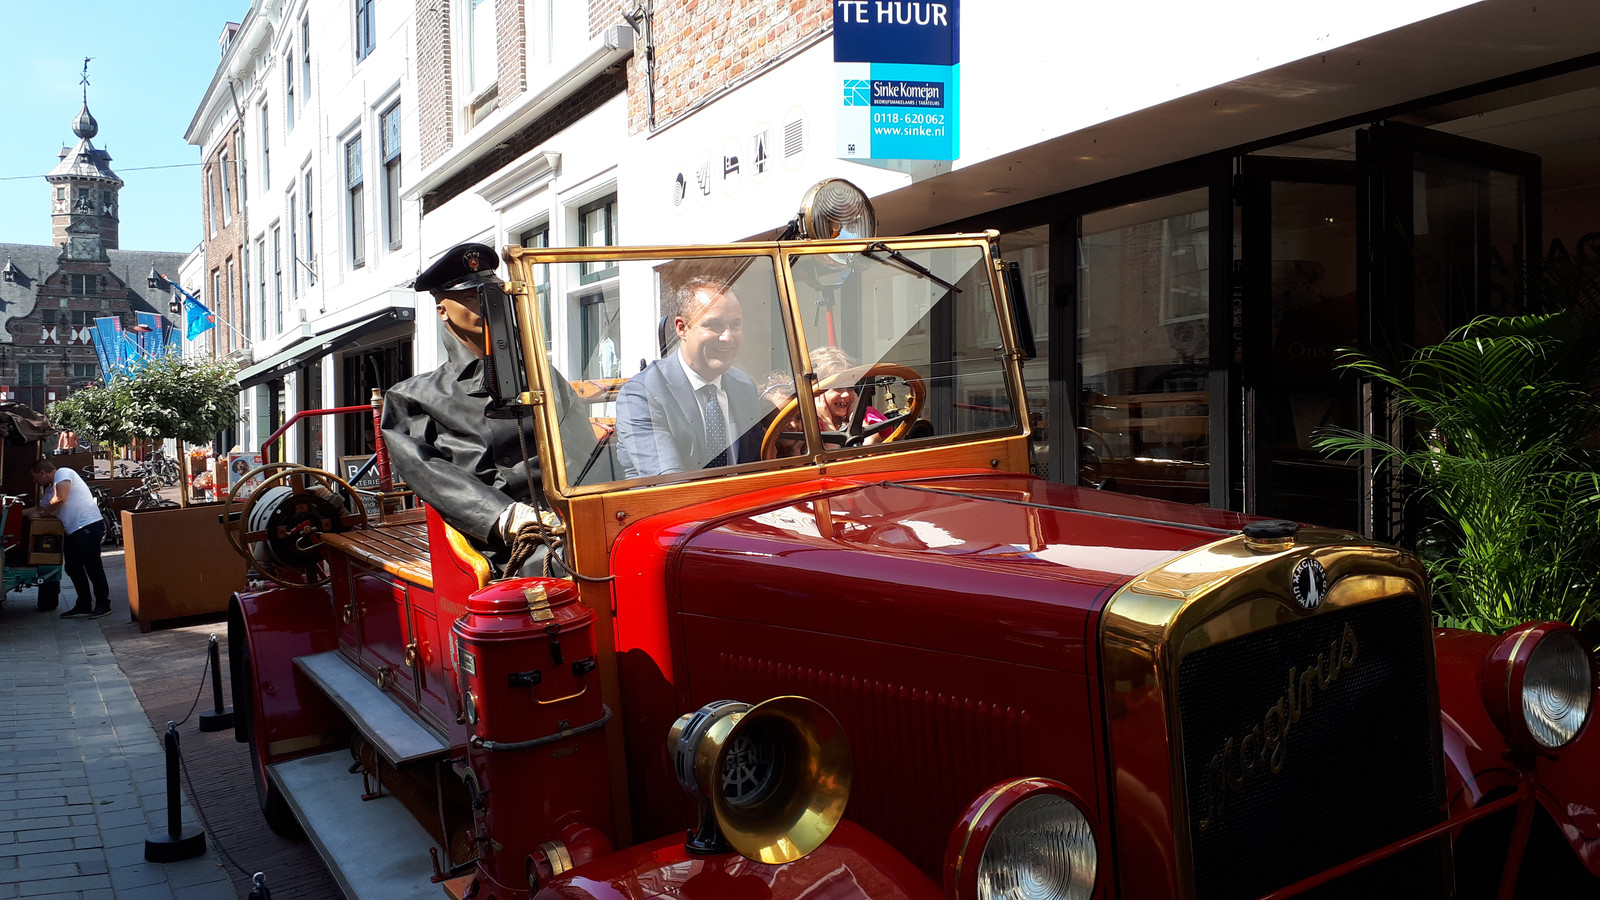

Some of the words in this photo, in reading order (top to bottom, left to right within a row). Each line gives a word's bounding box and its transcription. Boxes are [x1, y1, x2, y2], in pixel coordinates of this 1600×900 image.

[838, 1, 869, 23] TE
[876, 1, 948, 26] HUUR
[874, 81, 900, 97] Sinke
[874, 125, 945, 136] www.sinke.nl
